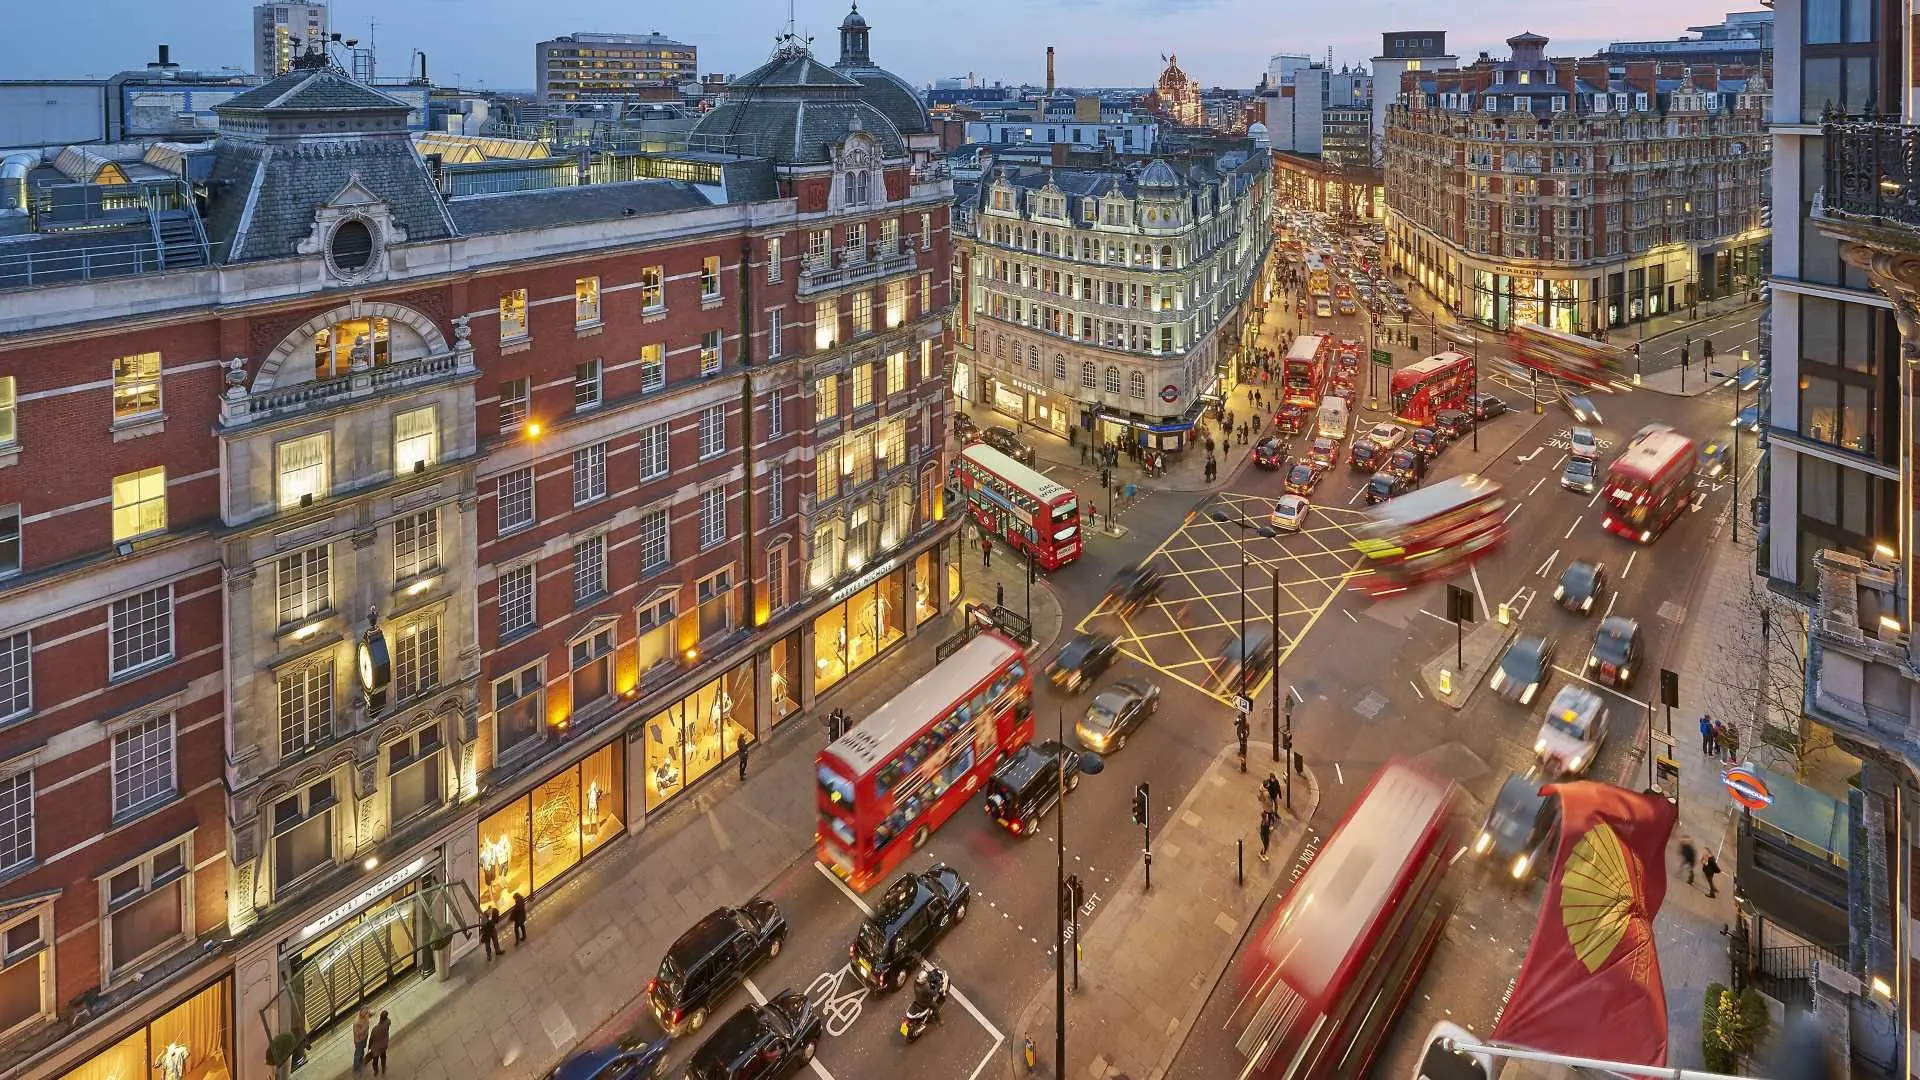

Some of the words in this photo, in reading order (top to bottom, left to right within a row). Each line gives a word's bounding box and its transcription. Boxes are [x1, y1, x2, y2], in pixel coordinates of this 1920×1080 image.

[1495, 266, 1544, 276] BURBERRY
[1299, 843, 1317, 865] LOOK
[1080, 892, 1102, 917] LEFT
